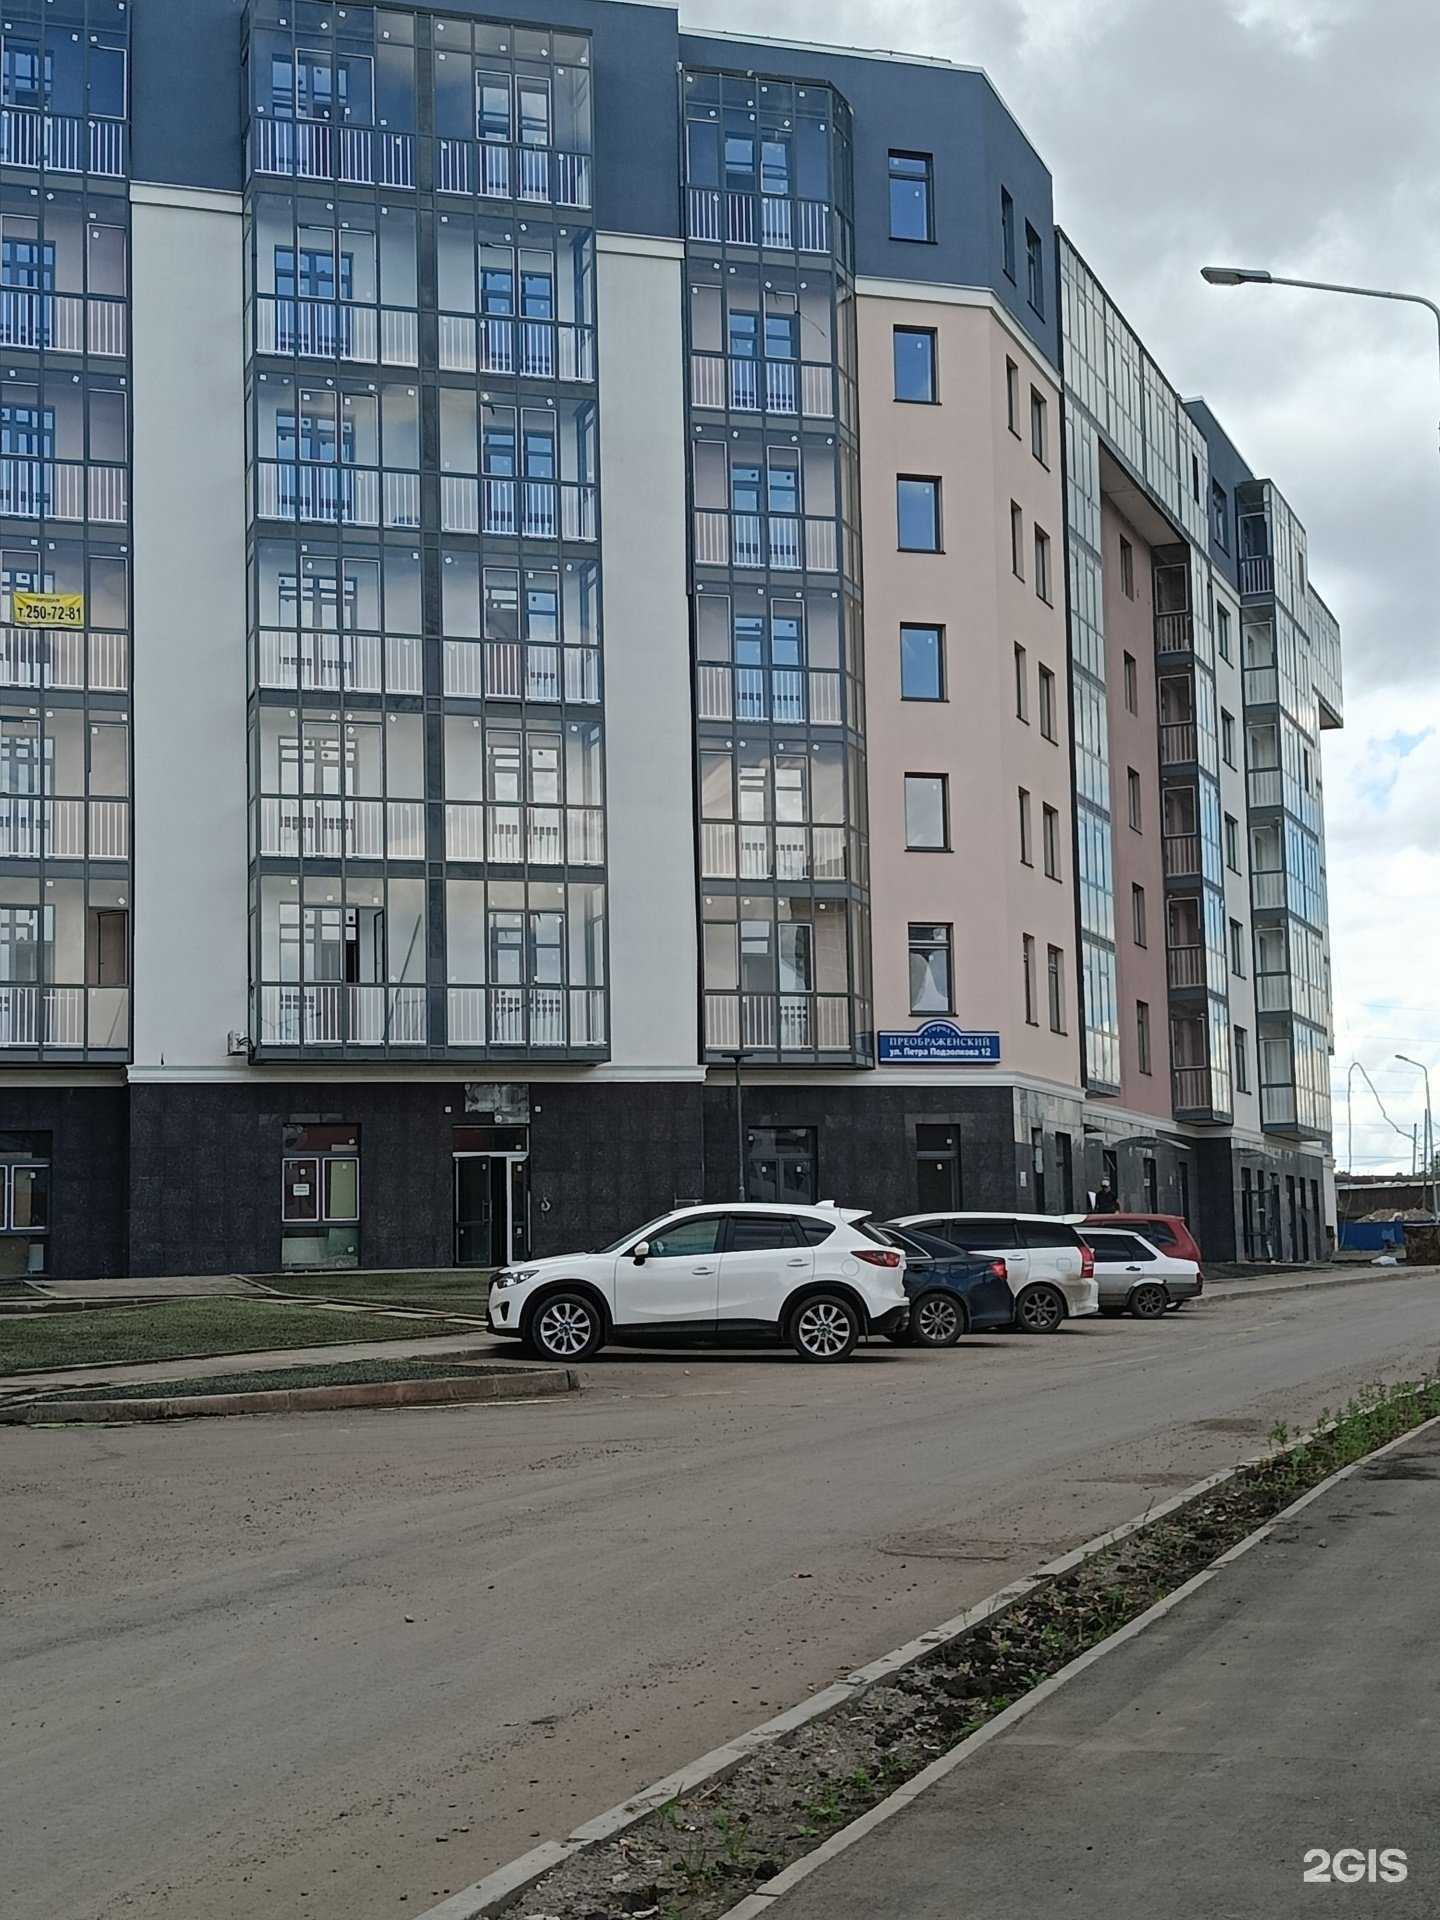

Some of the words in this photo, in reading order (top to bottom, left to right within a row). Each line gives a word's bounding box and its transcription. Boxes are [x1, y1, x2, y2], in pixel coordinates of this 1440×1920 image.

[889, 1037, 990, 1046] ПРЕОБРАЖЕНСКИЙ
[889, 1048, 902, 1057] ул.
[904, 1047, 928, 1057] Петра
[930, 1047, 979, 1056] Подзолкова
[981, 1047, 991, 1056] 12
